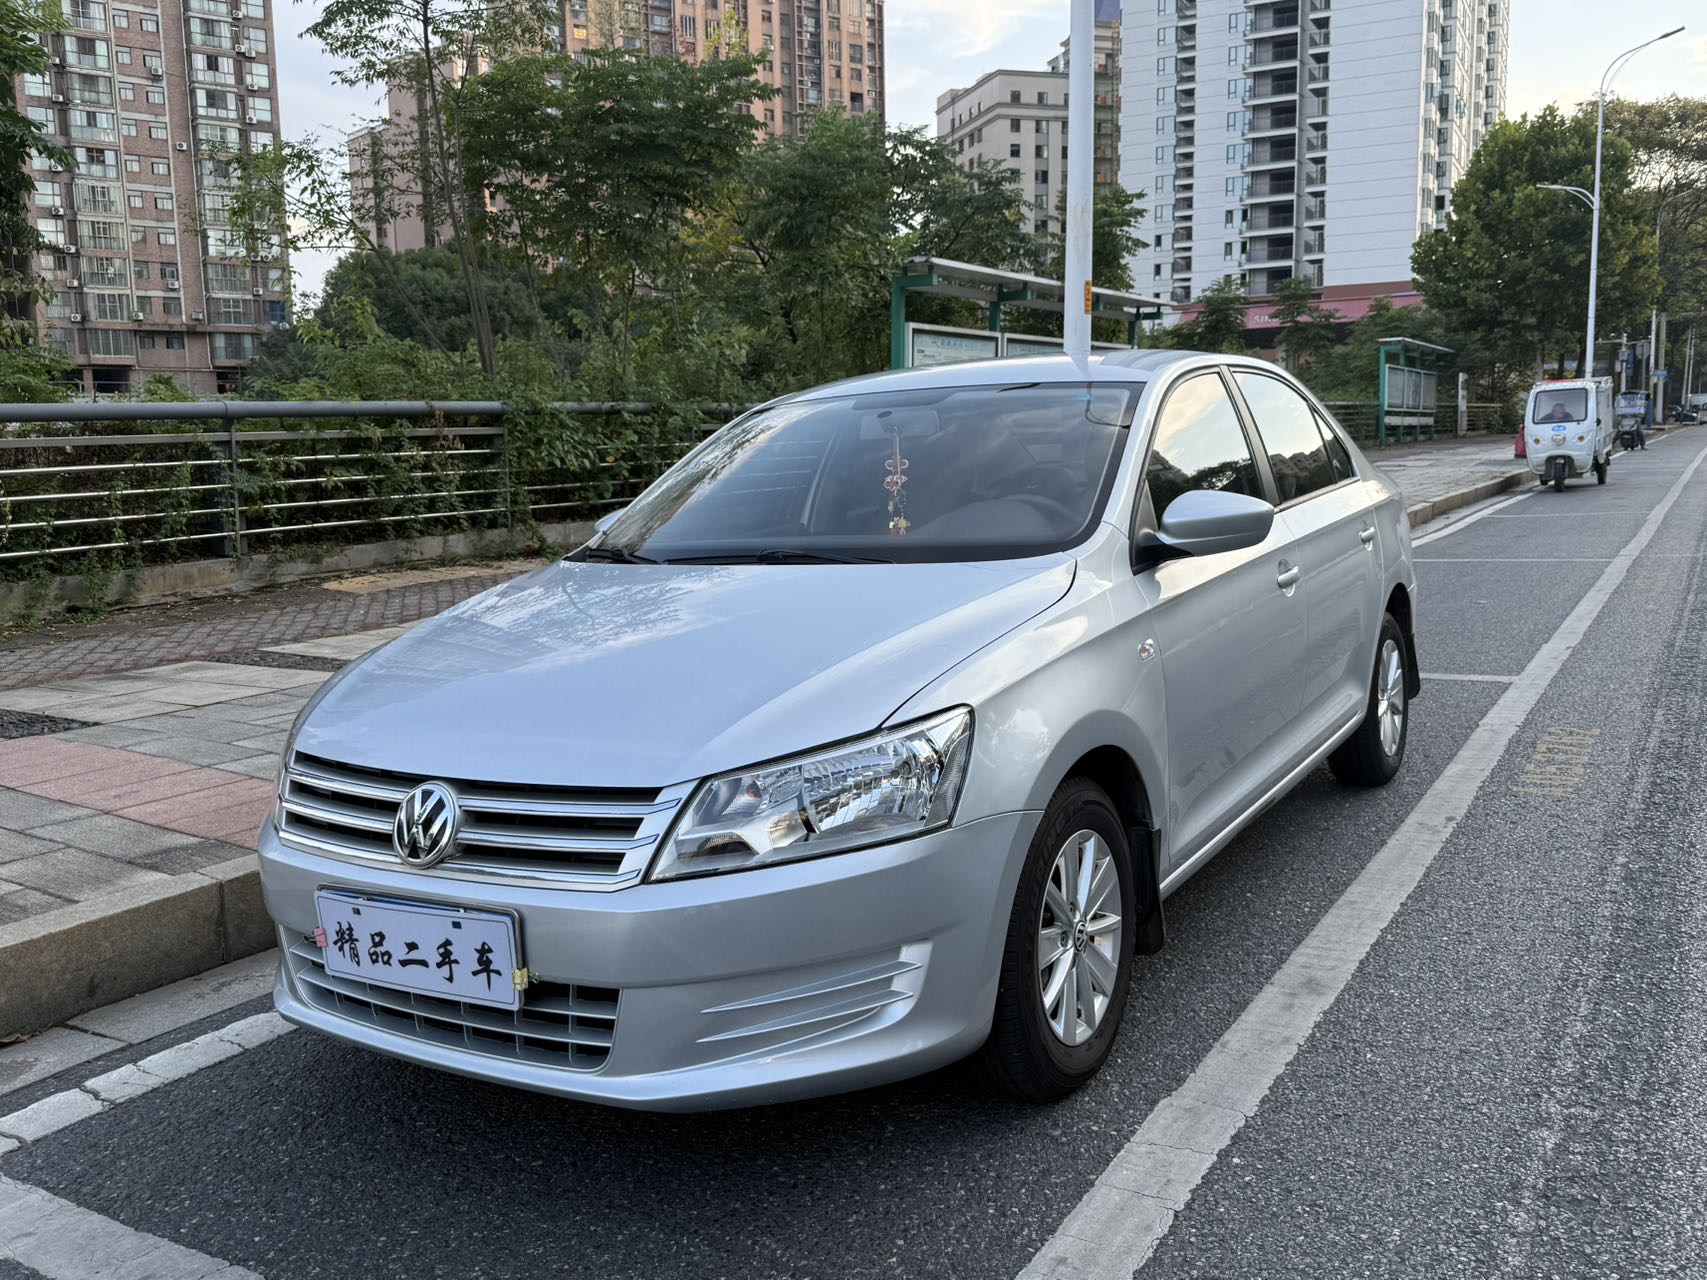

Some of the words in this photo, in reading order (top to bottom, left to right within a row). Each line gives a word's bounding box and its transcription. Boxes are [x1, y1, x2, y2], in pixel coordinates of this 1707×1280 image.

[332, 920, 502, 992] 精品二手车
